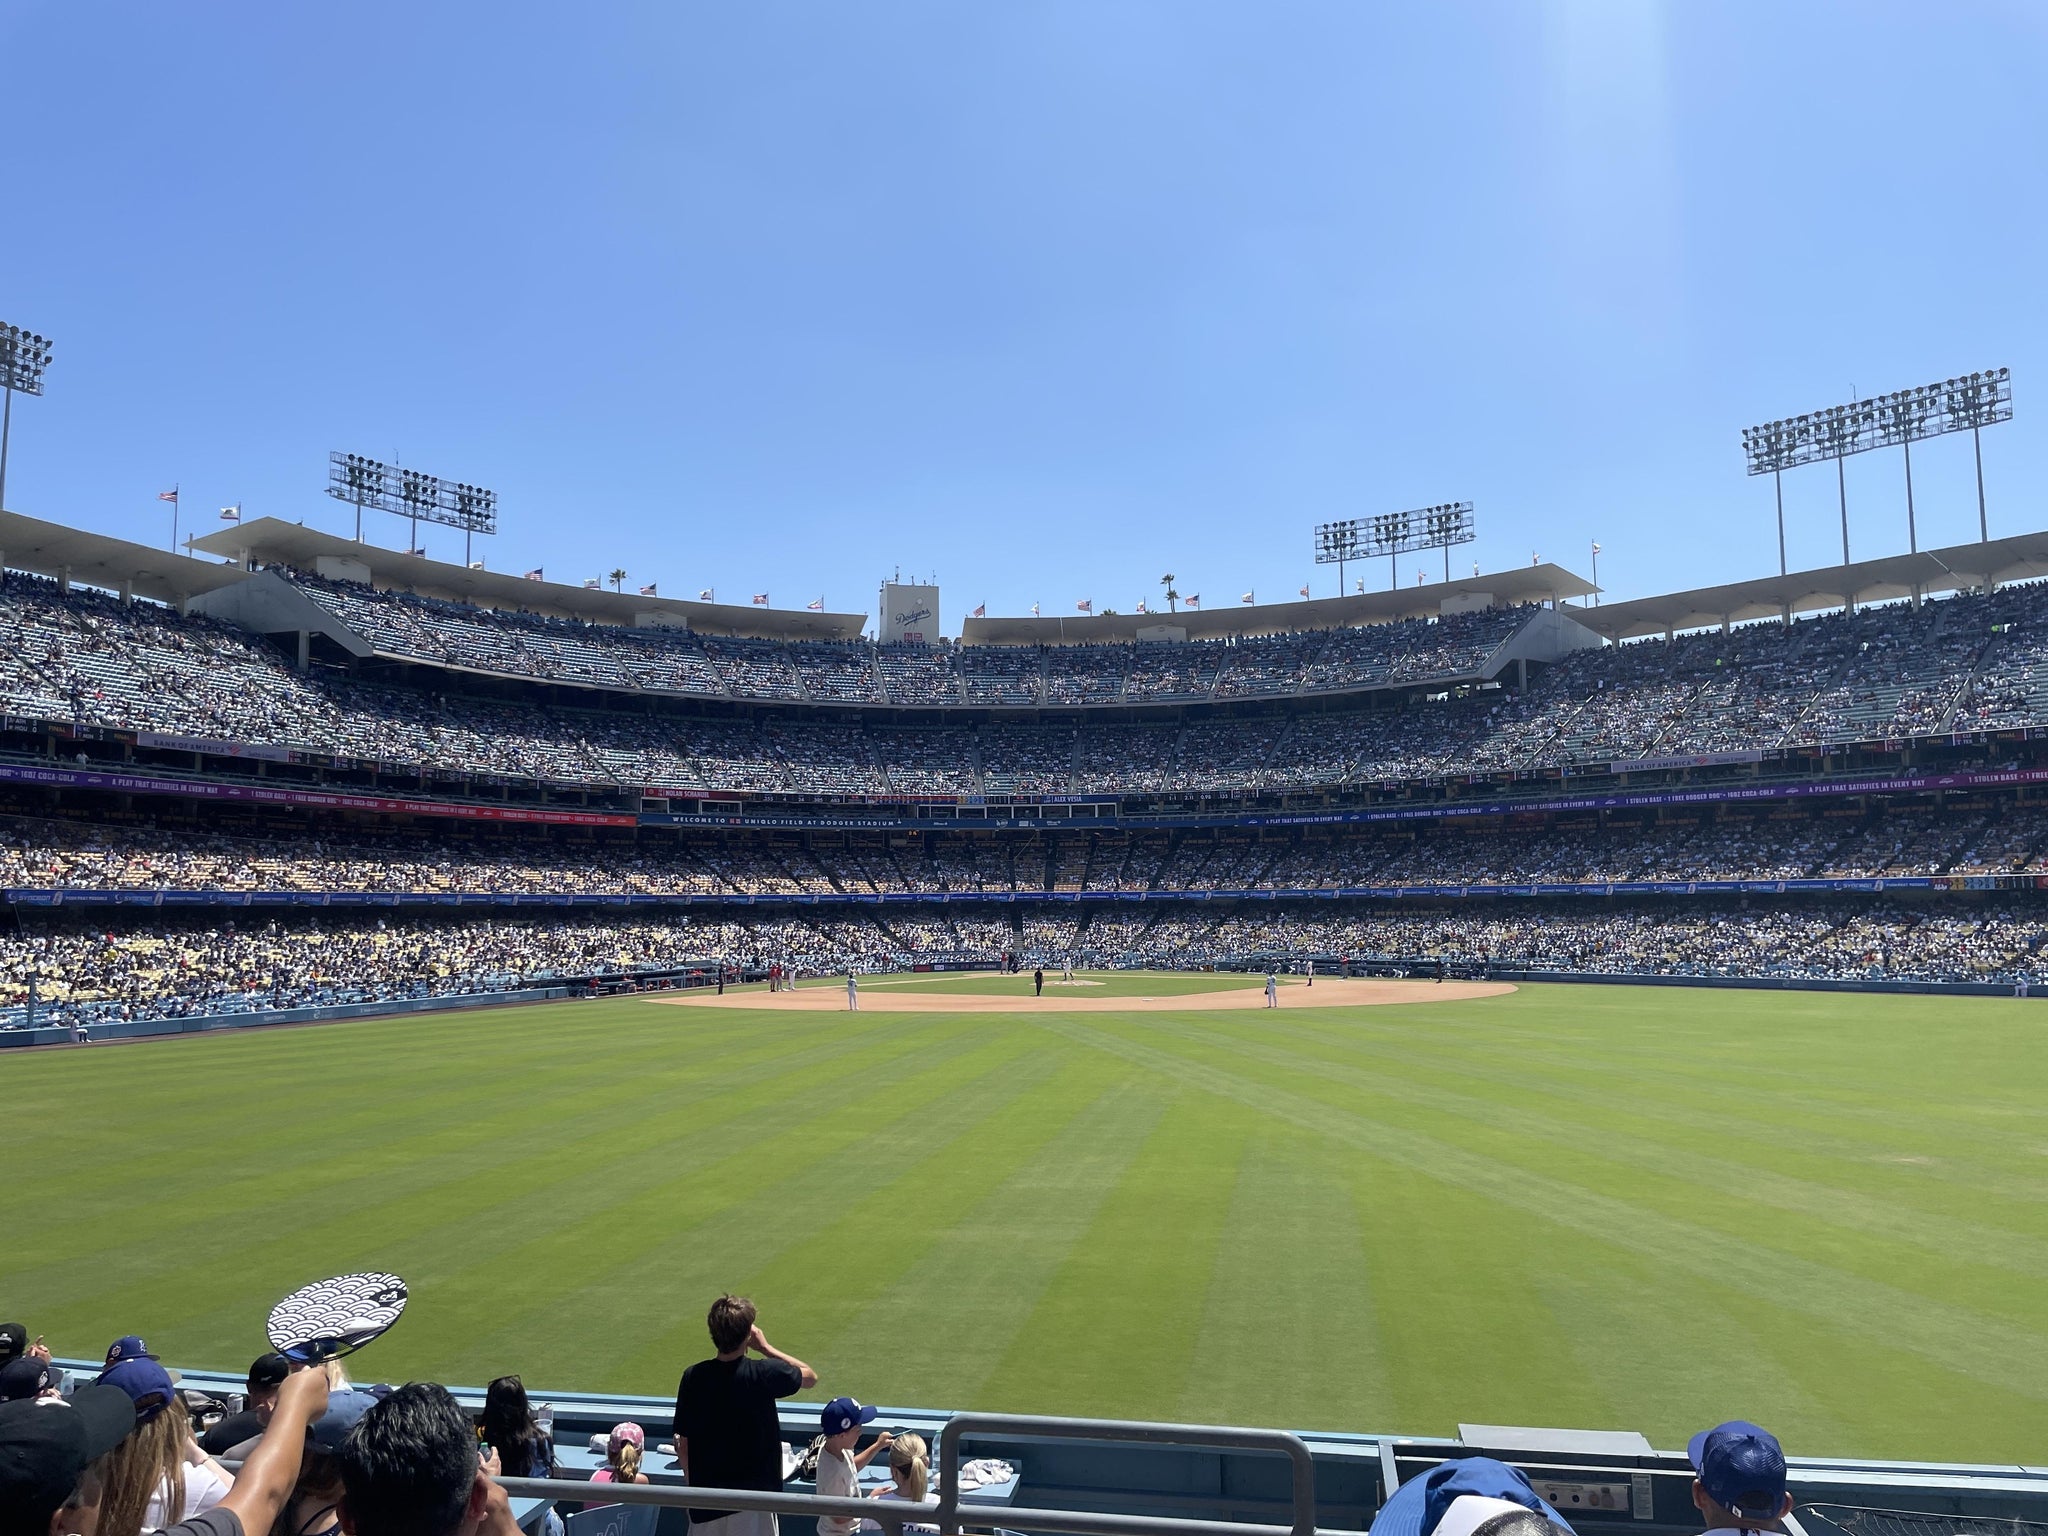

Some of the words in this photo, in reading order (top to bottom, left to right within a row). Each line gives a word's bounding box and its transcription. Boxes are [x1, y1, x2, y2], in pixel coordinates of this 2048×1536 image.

[895, 608, 931, 626] Dodgers
[154, 739, 176, 748] BANK
[190, 744, 225, 754] AMERICA
[1625, 763, 1645, 771] BANK
[1658, 760, 1691, 768] AMERICA
[118, 779, 133, 787] PLAY
[135, 780, 150, 788] THAT
[1848, 782, 1880, 790] SATISFIES
[1890, 780, 1910, 788] EVERY
[1912, 779, 1925, 787] WAY
[1974, 775, 1999, 783] STOLEN
